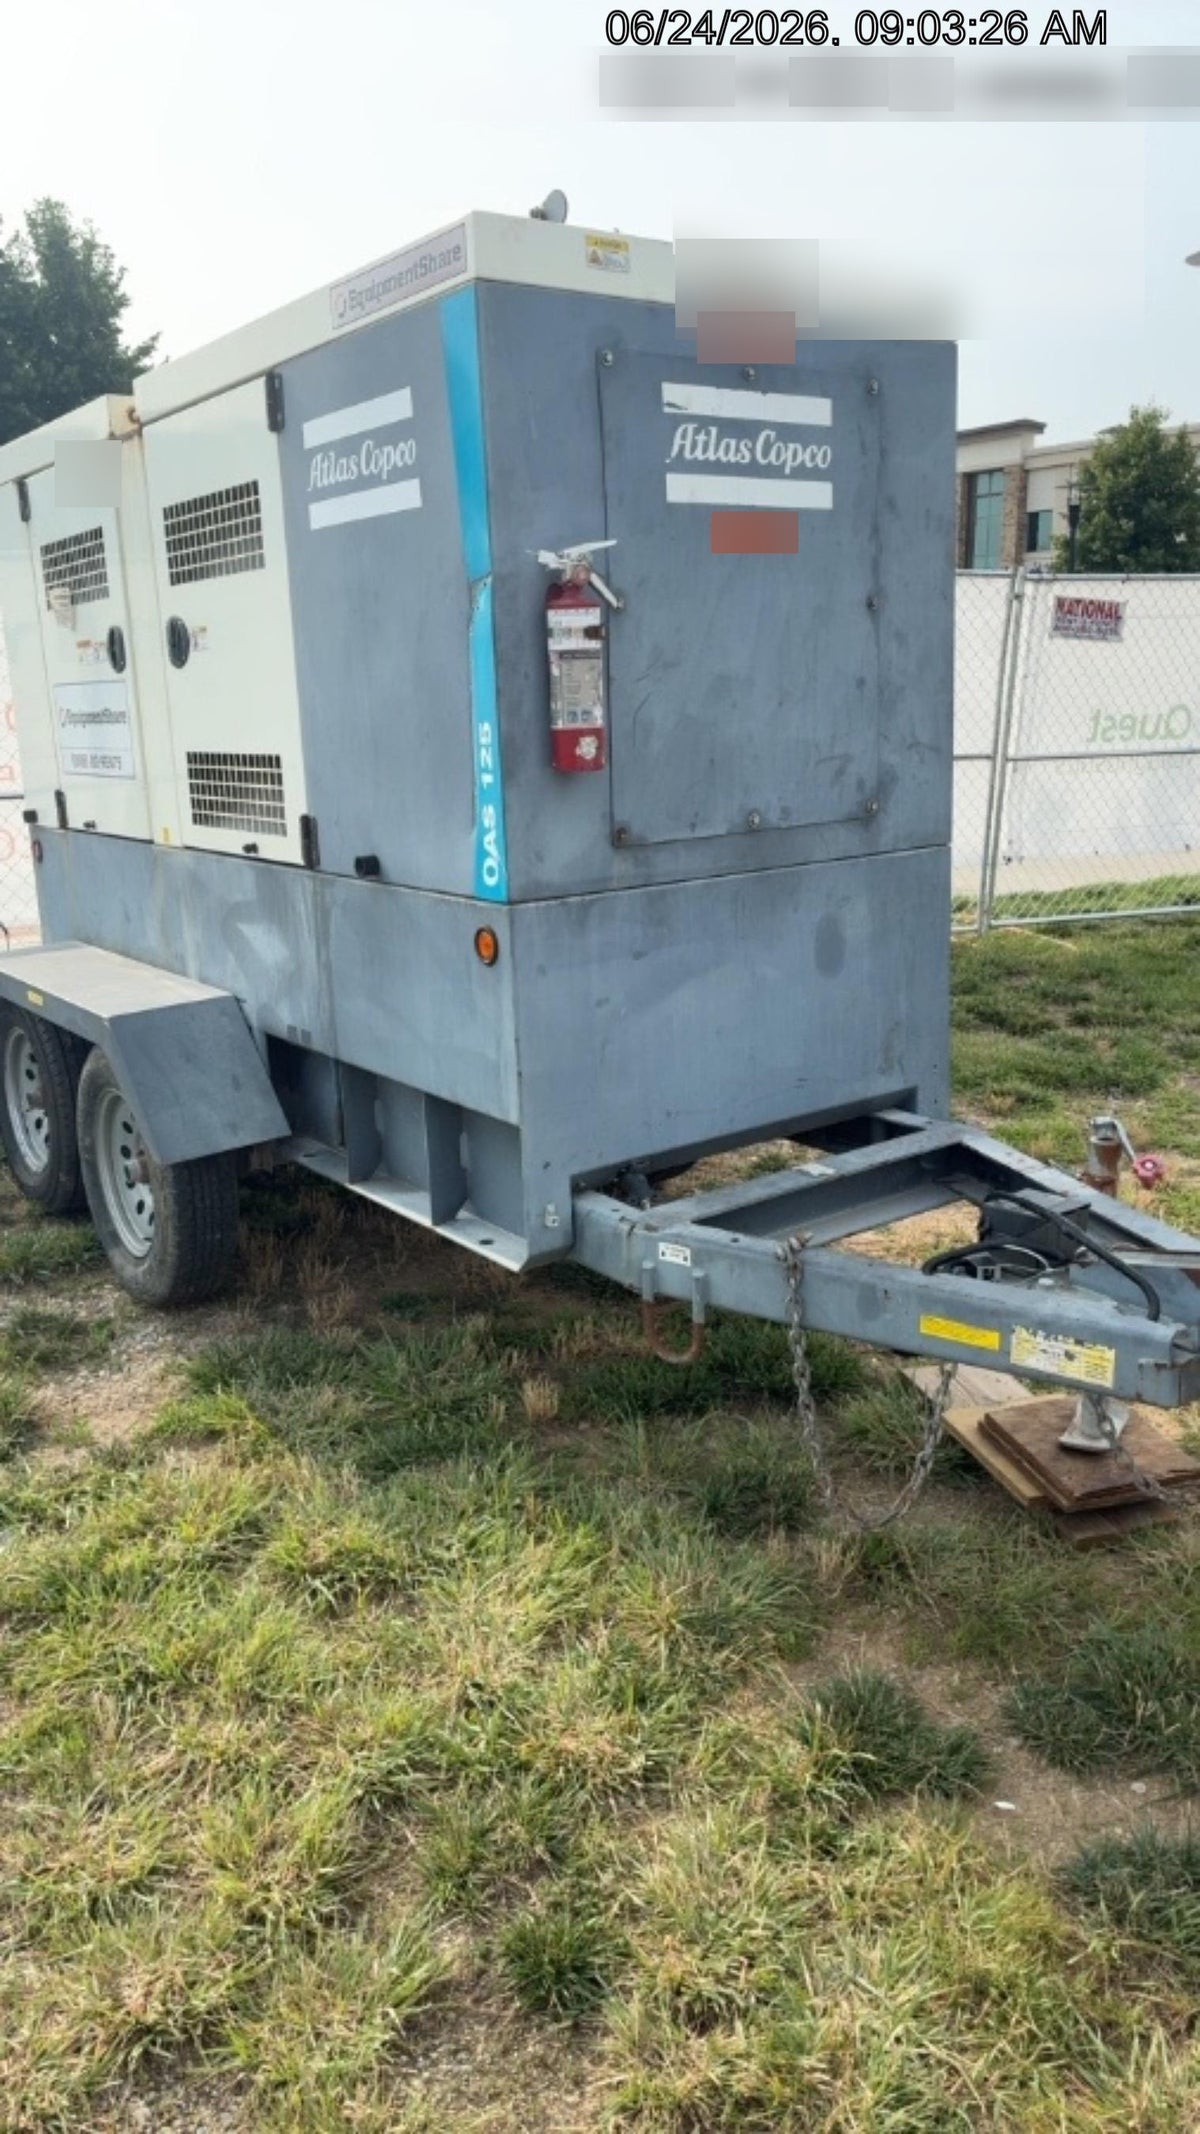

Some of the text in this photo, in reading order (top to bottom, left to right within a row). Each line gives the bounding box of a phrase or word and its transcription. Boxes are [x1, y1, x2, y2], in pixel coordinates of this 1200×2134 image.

[348, 244, 461, 311] EquipmentShare
[306, 438, 416, 492] Atlas Copco
[666, 423, 832, 475] Atlas Copco
[1055, 597, 1122, 619] NATIONAL
[478, 721, 494, 791] 125
